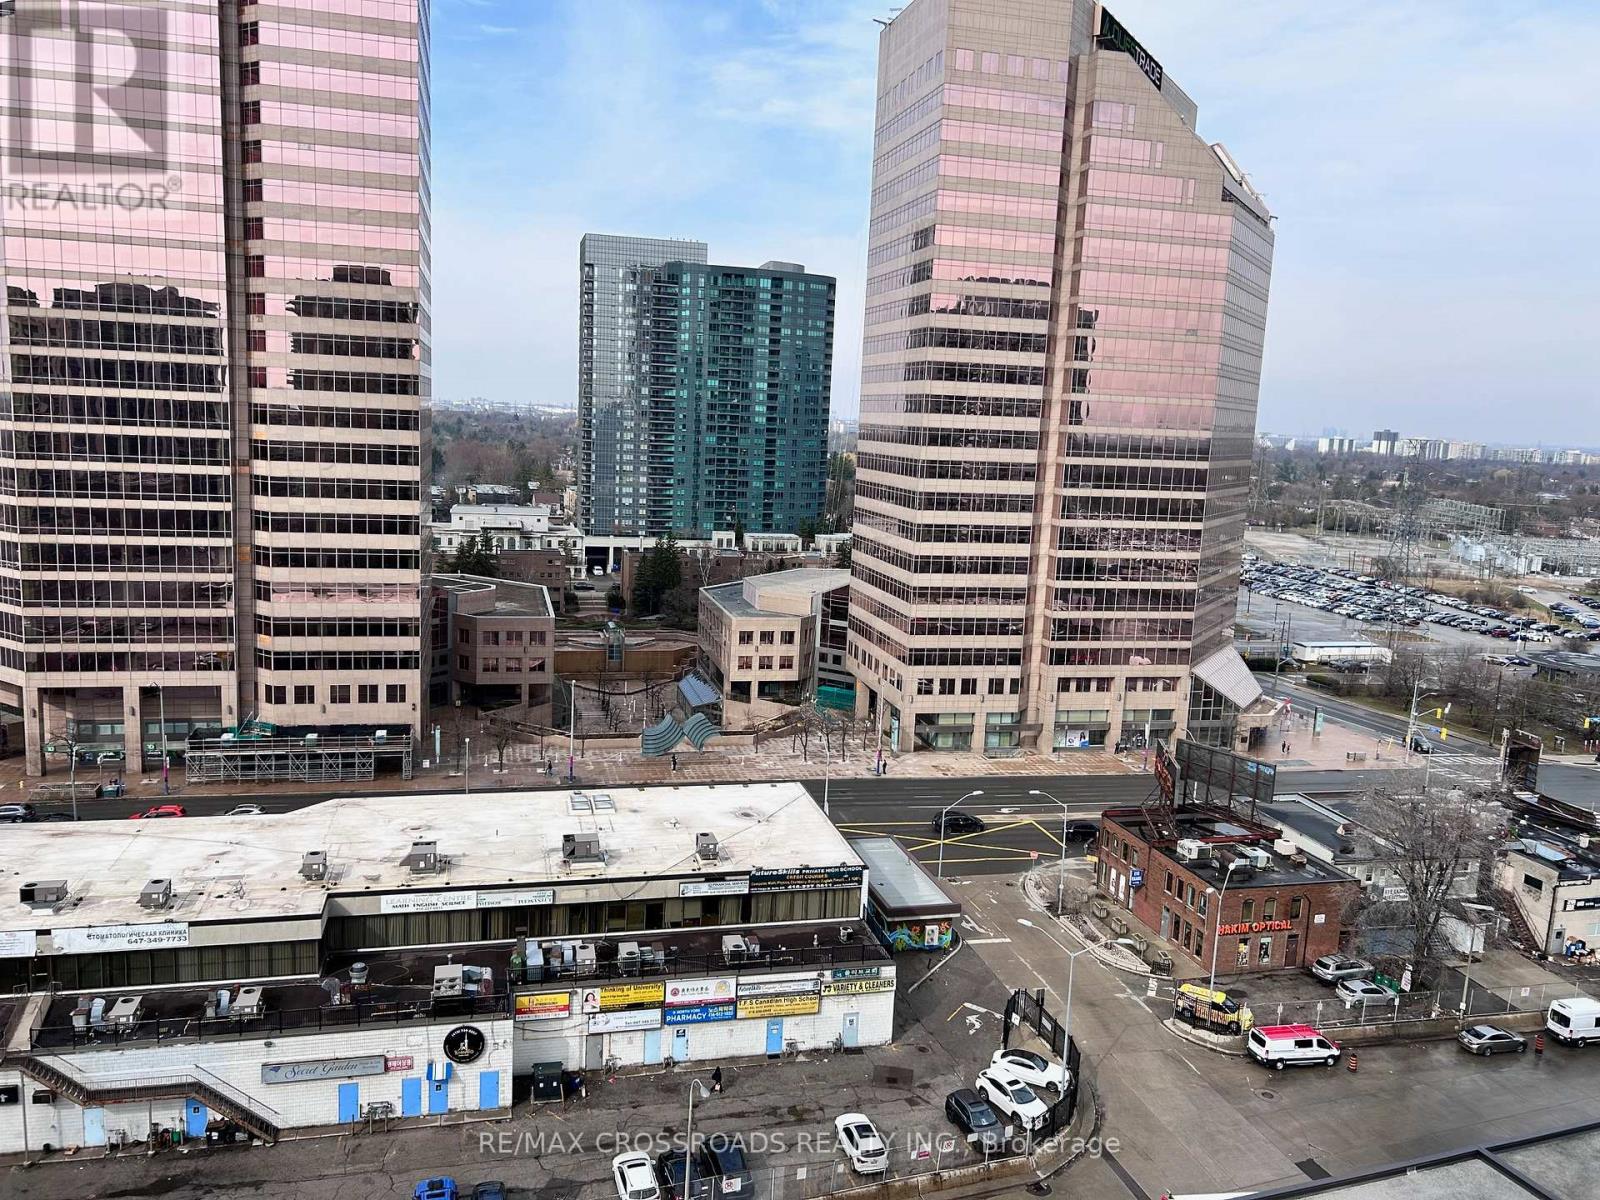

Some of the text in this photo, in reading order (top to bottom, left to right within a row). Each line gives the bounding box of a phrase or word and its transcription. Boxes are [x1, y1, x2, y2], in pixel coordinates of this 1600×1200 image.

[751, 868, 800, 876] FutureSkills
[385, 896, 433, 905] LEARNING
[436, 894, 473, 903] CENTRE
[1218, 919, 1293, 936] HAKIM OPTICAL
[127, 935, 188, 945] 647-349-7733
[600, 985, 625, 994] Thinking
[625, 984, 633, 992] of
[832, 982, 857, 992] VARIETY
[864, 979, 895, 990] CLEANERS
[754, 997, 783, 1006] Canadian
[783, 996, 798, 1004] High
[666, 1012, 707, 1022] PHARMACY
[284, 1065, 318, 1080] Secret
[319, 1060, 359, 1076] Garden
